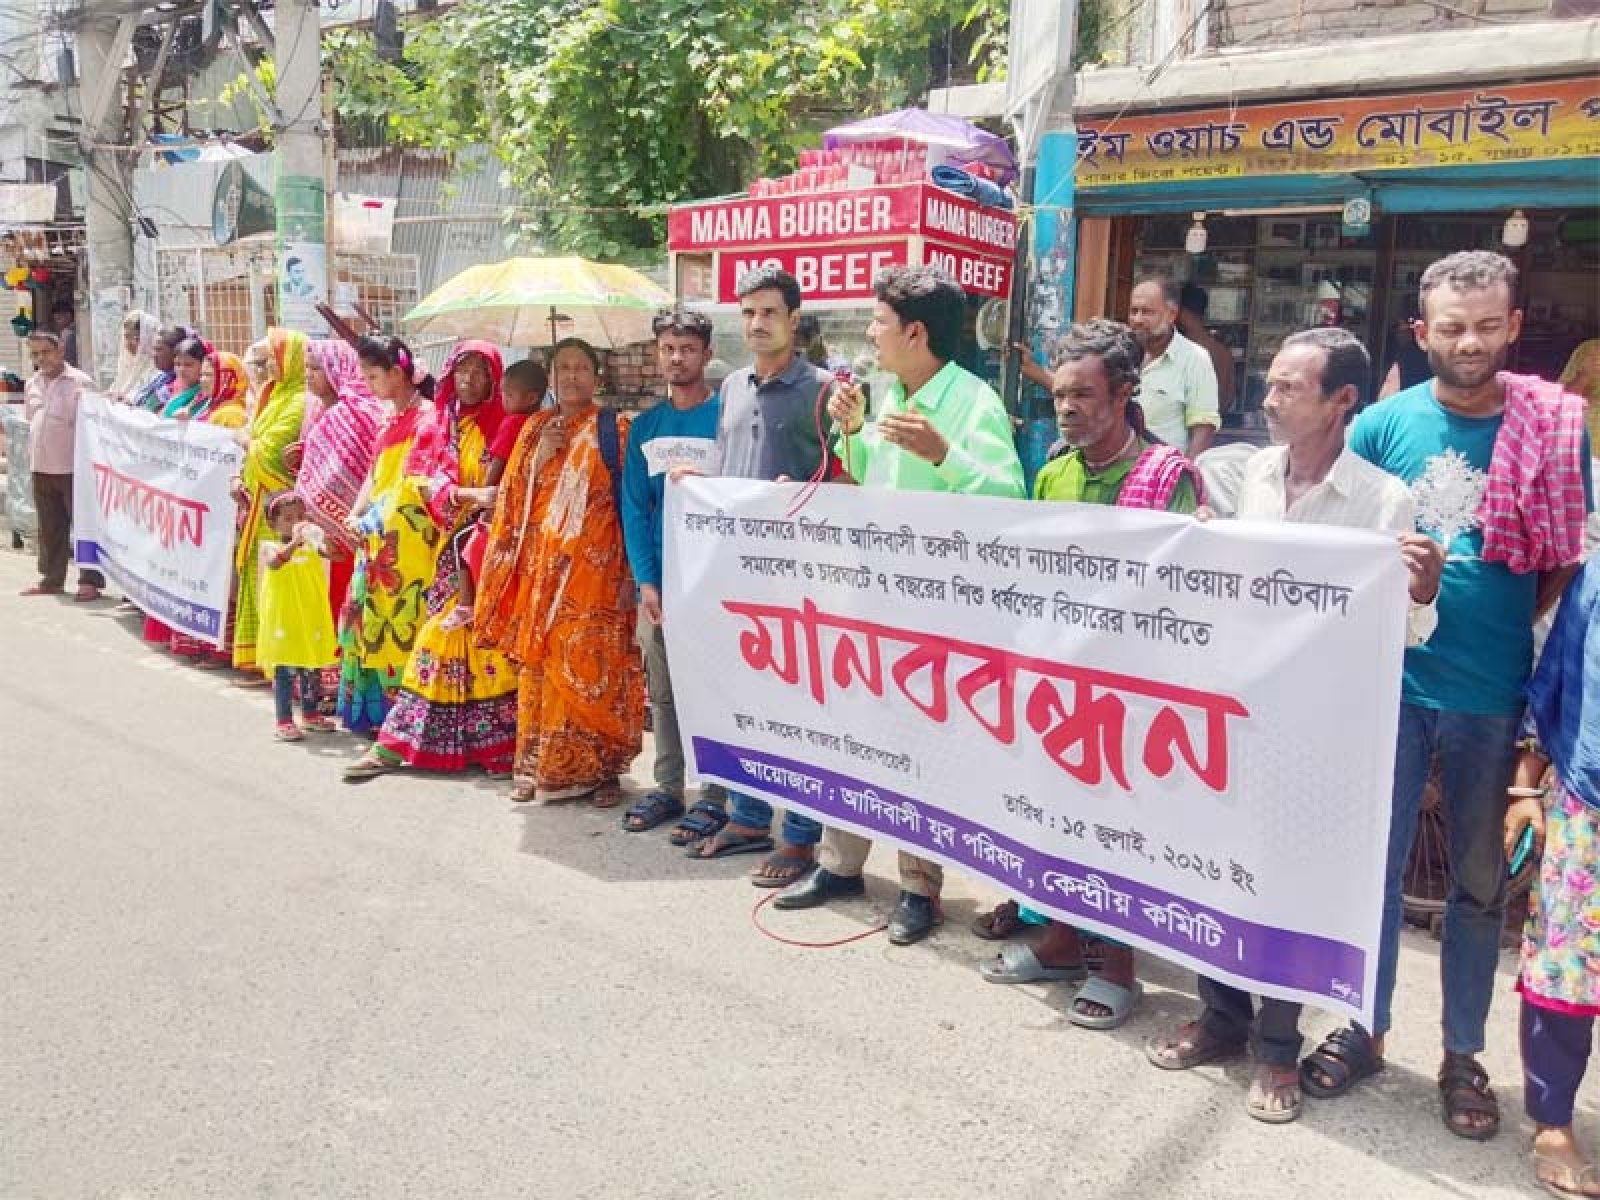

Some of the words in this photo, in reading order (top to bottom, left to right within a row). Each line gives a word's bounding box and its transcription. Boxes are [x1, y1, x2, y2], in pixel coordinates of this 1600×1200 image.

[1146, 122, 1247, 160] ওয়াচ
[1261, 117, 1342, 151] এন্ড
[1356, 94, 1559, 147] মোবাইল
[691, 206, 772, 243] MAMA
[779, 195, 891, 237] BURGER
[926, 197, 967, 238] MAMA
[968, 211, 1015, 250] BURGER
[795, 251, 893, 293] BEEF
[961, 257, 1005, 291] BEEF
[739, 555, 797, 577] সমাবেশ
[803, 562, 815, 579] ও
[877, 573, 889, 592] ৭
[893, 573, 947, 601] বছরের
[951, 575, 984, 606] শিশু
[992, 582, 1046, 619] ধর্ষণের
[1053, 591, 1126, 635] বিচারের
[1131, 606, 1213, 646] দাবিতে
[740, 517, 795, 541] তানোরে
[846, 522, 916, 556] আদিবাসী
[920, 530, 970, 561] তরুণী
[976, 536, 1022, 569] ধর্ষণে
[1026, 545, 1120, 583] ন্যায়বিচার
[1126, 558, 1149, 588] না
[1155, 562, 1243, 601] পাওয়ায়
[1250, 568, 1353, 616] প্রতিবাদ
[721, 597, 1250, 793] মানববন্ধন
[739, 757, 824, 800] আয়োজনে
[839, 785, 922, 833] আদিবাসী
[927, 816, 957, 849] যুব
[1042, 870, 1132, 918] কেন্দ্রীয়
[1139, 898, 1226, 949] কমিটি
[1003, 793, 1044, 825] তারিখ
[1061, 815, 1086, 839] ১৫
[1163, 843, 1222, 881] ২০২৬
